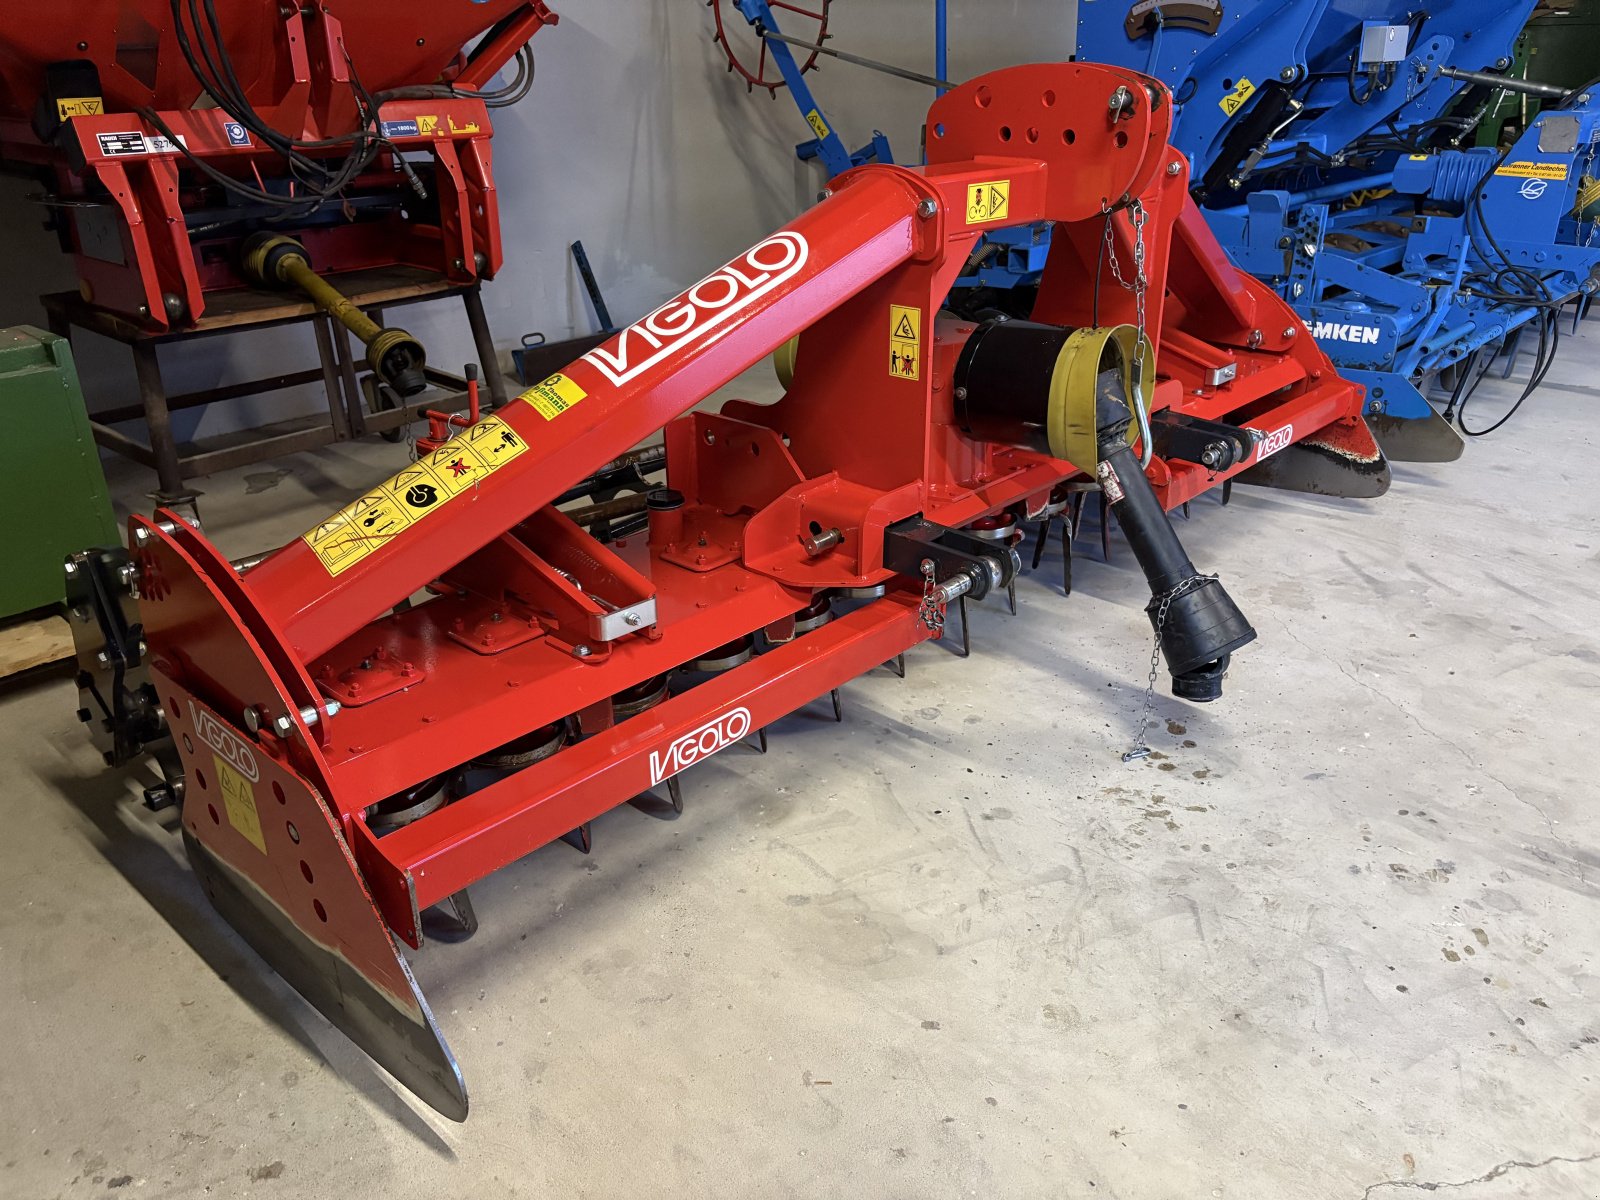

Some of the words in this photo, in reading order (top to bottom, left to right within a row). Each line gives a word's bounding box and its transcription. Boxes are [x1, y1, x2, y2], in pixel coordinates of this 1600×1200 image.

[580, 231, 809, 388] VIGOLO
[1256, 423, 1293, 463] VIGOLO
[187, 699, 260, 784] VIGOLO
[649, 706, 752, 787] VIGOLO
